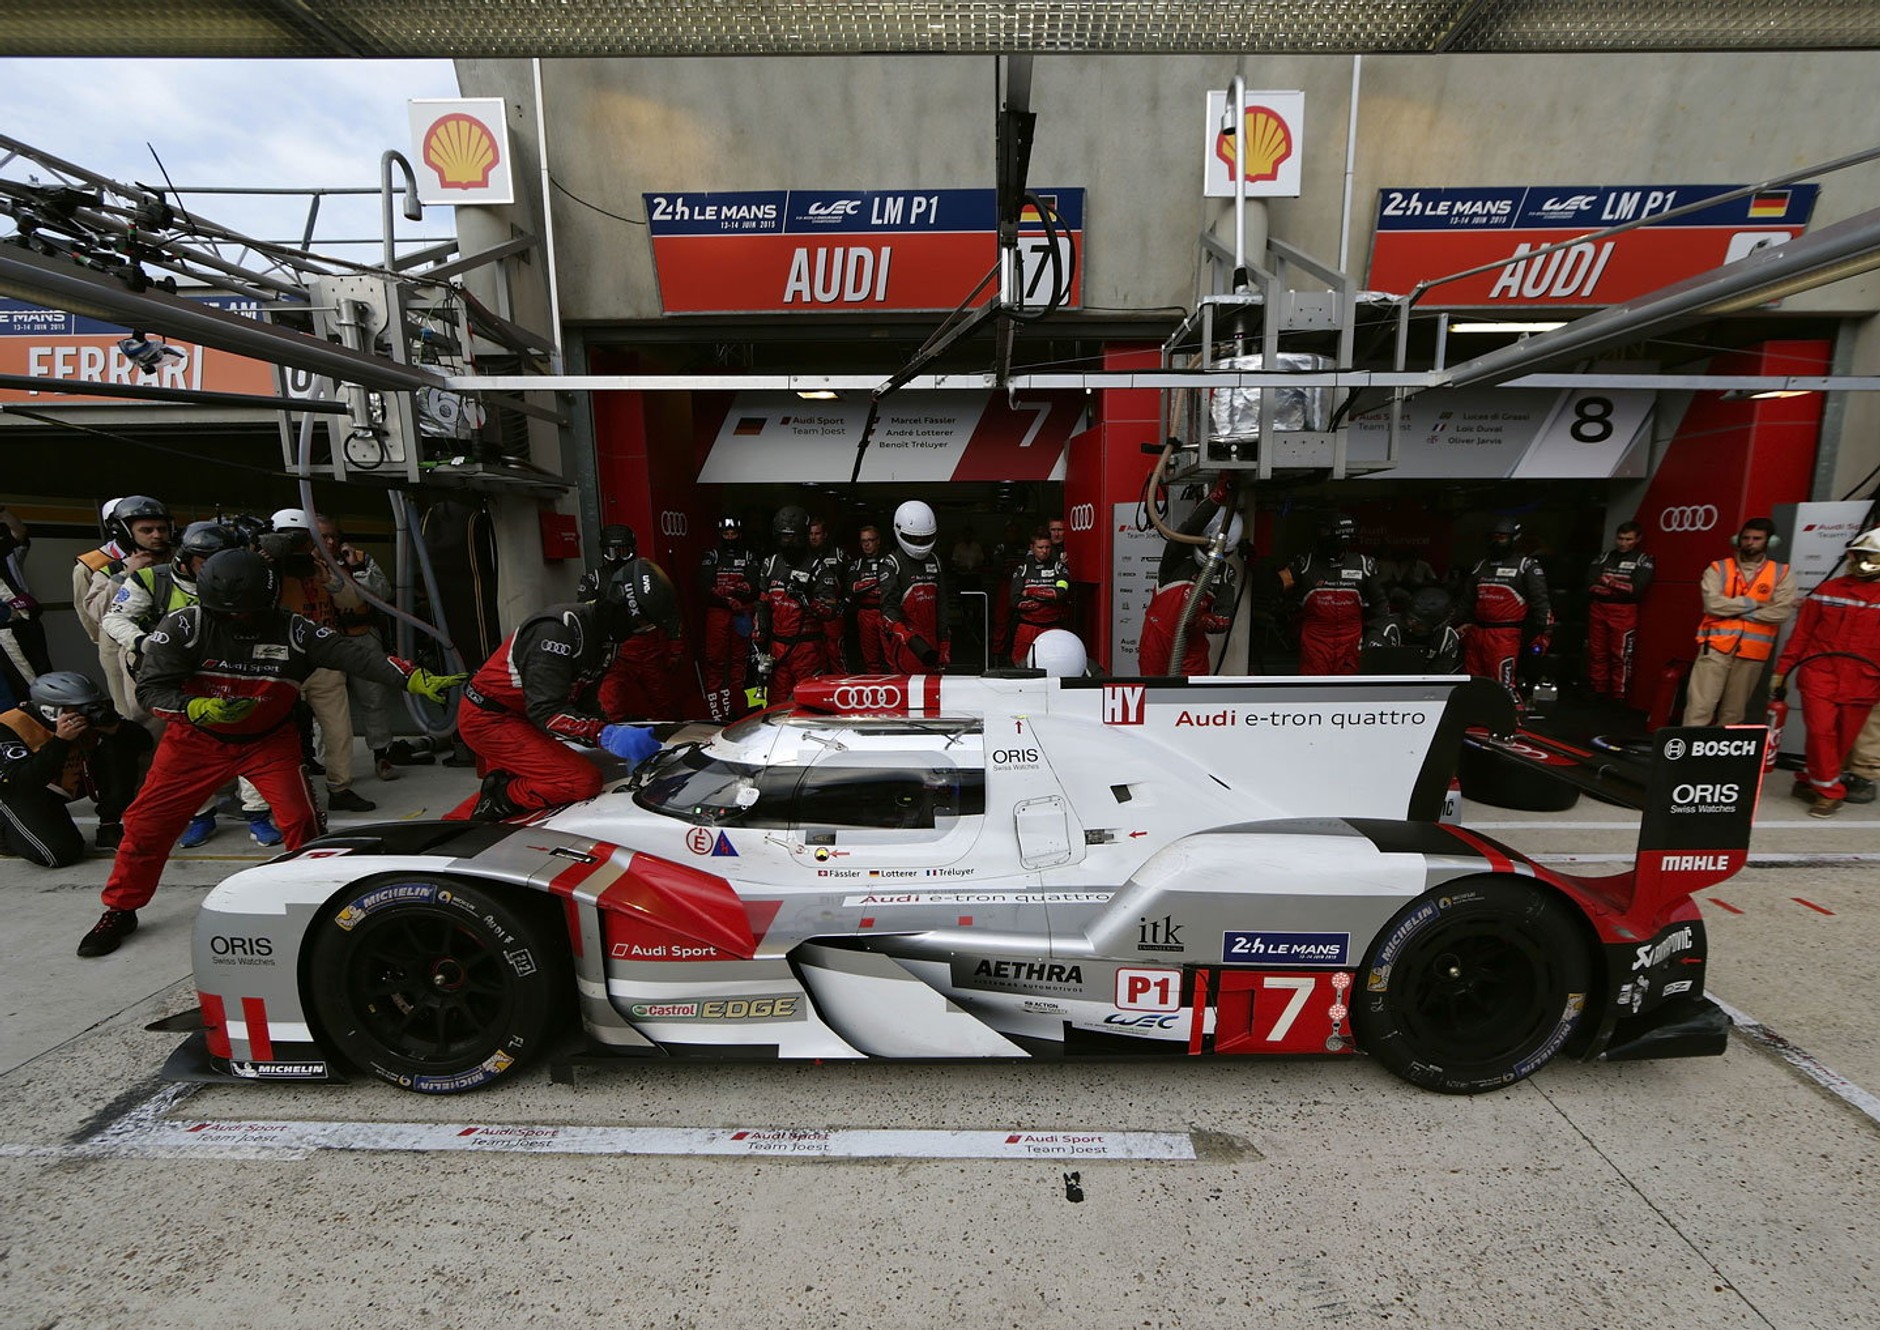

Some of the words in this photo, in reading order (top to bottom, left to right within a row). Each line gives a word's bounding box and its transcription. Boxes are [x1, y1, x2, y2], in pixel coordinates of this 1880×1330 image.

[694, 206, 717, 220] LE
[721, 205, 777, 219] MANS
[871, 196, 904, 225] LM
[909, 196, 938, 225] P1
[1425, 202, 1449, 215] LE
[1453, 200, 1513, 215] MANS
[1601, 191, 1642, 221] LM
[1641, 190, 1677, 219] P1
[720, 221, 739, 229] 13-14
[760, 220, 776, 228] 2015
[783, 246, 892, 303] AUDI
[1025, 244, 1052, 298] 7
[1489, 241, 1616, 298] AUDI
[0, 310, 9, 323] E
[13, 310, 66, 323] MANS
[793, 417, 815, 425] Audi
[817, 417, 845, 426] Sport
[891, 417, 921, 425] Marcel
[924, 416, 957, 425] Fässler
[1359, 413, 1380, 421] Audi
[1380, 413, 1411, 422] Srt
[1463, 413, 1488, 421] Lucas
[1570, 396, 1614, 443] 8
[792, 427, 819, 435] Team
[821, 427, 846, 436] Joest
[1019, 402, 1051, 447] 7
[1358, 423, 1382, 431] Team
[1385, 423, 1412, 432] Jst
[1476, 425, 1503, 433] Duval
[886, 428, 913, 436] André
[915, 429, 954, 437] Lotterer
[879, 440, 908, 449] Benoît
[912, 440, 948, 450] Tréluyer
[1448, 437, 1474, 445] Oliver
[1476, 437, 1502, 445] Jarvis
[624, 582, 641, 617] uvex
[218, 659, 248, 671] Audi
[249, 661, 281, 673] Sport
[707, 692, 723, 722] Back
[720, 689, 731, 716] Pus
[1103, 686, 1144, 723] HY
[1175, 710, 1236, 727] Audi
[1244, 710, 1322, 726] e-tron
[1330, 709, 1426, 729] quattro
[1691, 741, 1756, 756] BOSCH
[992, 748, 1039, 764] ORIS
[993, 764, 1012, 772] Swiss
[1013, 763, 1040, 771] Watches
[1672, 784, 1740, 804] ORIS
[1670, 805, 1696, 814] Swiss
[1698, 805, 1736, 813] Watches
[1661, 855, 1729, 871] MAHLE
[829, 869, 861, 878] Fässler
[881, 869, 918, 878] Lotterer
[938, 867, 975, 877] Tréluyer
[362, 886, 434, 909] MICHELIN
[860, 894, 920, 903] Audi
[929, 893, 1006, 903] e-tron
[1014, 892, 1110, 904] quattro
[1138, 914, 1184, 945] itk
[1381, 905, 1434, 962] MICHELIN
[210, 935, 273, 957] ORIS
[631, 944, 667, 956] Audi
[671, 944, 717, 958] Sport
[1267, 945, 1289, 954] LE
[1291, 944, 1341, 955] MANS
[212, 956, 237, 966] Swiss
[238, 956, 276, 967] Watches
[974, 959, 1083, 984] AETHRA
[1023, 983, 1083, 993] AUTOMOTIVOS
[1127, 976, 1170, 1005] P1
[649, 1004, 695, 1016] Castrol
[701, 997, 799, 1019] EDGE
[1263, 976, 1316, 1042] 7
[258, 1064, 324, 1074] MICHELIN
[418, 1072, 485, 1091] MICHELIN
[210, 1123, 243, 1132] Audi
[247, 1124, 288, 1133] Sport
[477, 1127, 514, 1135] Audi
[516, 1127, 559, 1138] Sport
[197, 1133, 236, 1142] Team
[236, 1133, 278, 1143] Joest
[470, 1137, 511, 1147] Team
[512, 1138, 553, 1148] Joest
[749, 1131, 786, 1140] Audi
[1024, 1134, 1059, 1143] Audi
[1062, 1134, 1104, 1144] Sport
[747, 1141, 790, 1150] Team
[790, 1141, 830, 1152] Joest
[1025, 1144, 1066, 1154] Team
[1068, 1144, 1108, 1154] Joest
